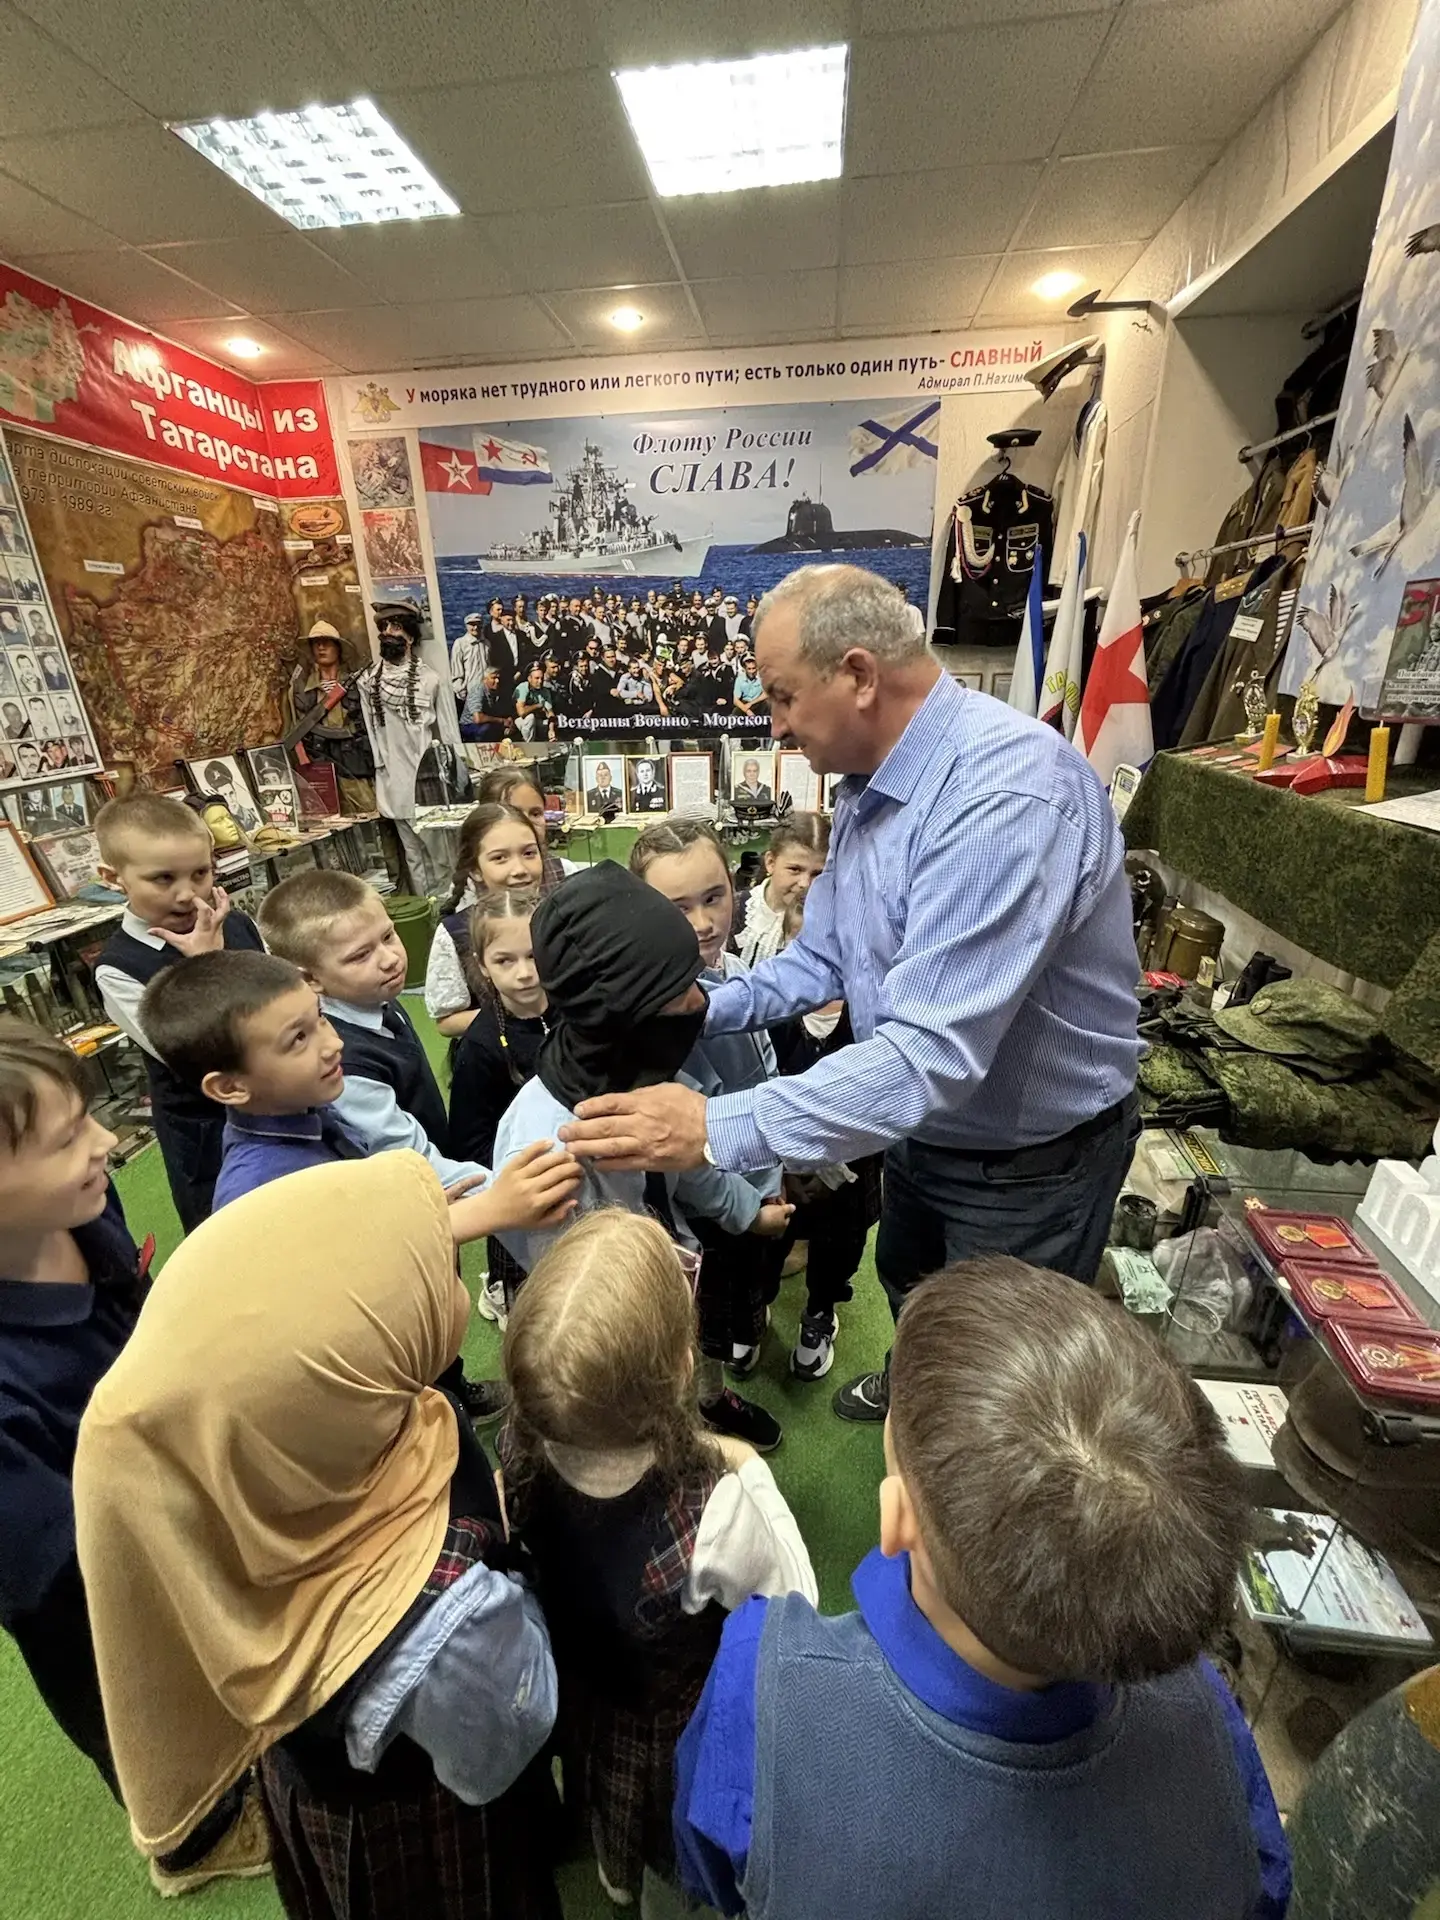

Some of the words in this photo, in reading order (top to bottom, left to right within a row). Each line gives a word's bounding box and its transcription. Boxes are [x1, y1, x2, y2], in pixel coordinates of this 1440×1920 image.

[111, 338, 264, 433] Афганцы
[272, 406, 320, 434] из
[406, 388, 416, 404] У
[420, 386, 477, 405] моряка
[481, 384, 508, 399] нет
[512, 378, 586, 399] трудного
[590, 375, 620, 391] или
[624, 371, 691, 389] легкого
[695, 366, 740, 388] пути;
[744, 366, 782, 381] есть
[785, 361, 846, 378] только
[850, 358, 894, 377] один
[950, 341, 1044, 369] СЛАВНЫЙ
[917, 375, 970, 391] Адмирал
[973, 370, 1027, 387] П.Нахим
[130, 399, 320, 481] Татарстана
[633, 433, 717, 457] Флоту
[724, 427, 813, 450] России
[5, 440, 44, 460] арта
[131, 471, 190, 496] советских
[650, 457, 796, 494] СЛАВА!
[12, 465, 20, 476] а
[28, 468, 116, 498] территории
[120, 486, 197, 514] Афганистана
[21, 485, 45, 504] 979
[62, 494, 94, 512] 1989
[557, 713, 631, 733] Ветераны
[634, 713, 691, 729] Военно
[1250, 1404, 1274, 1440] ТАТАРС
